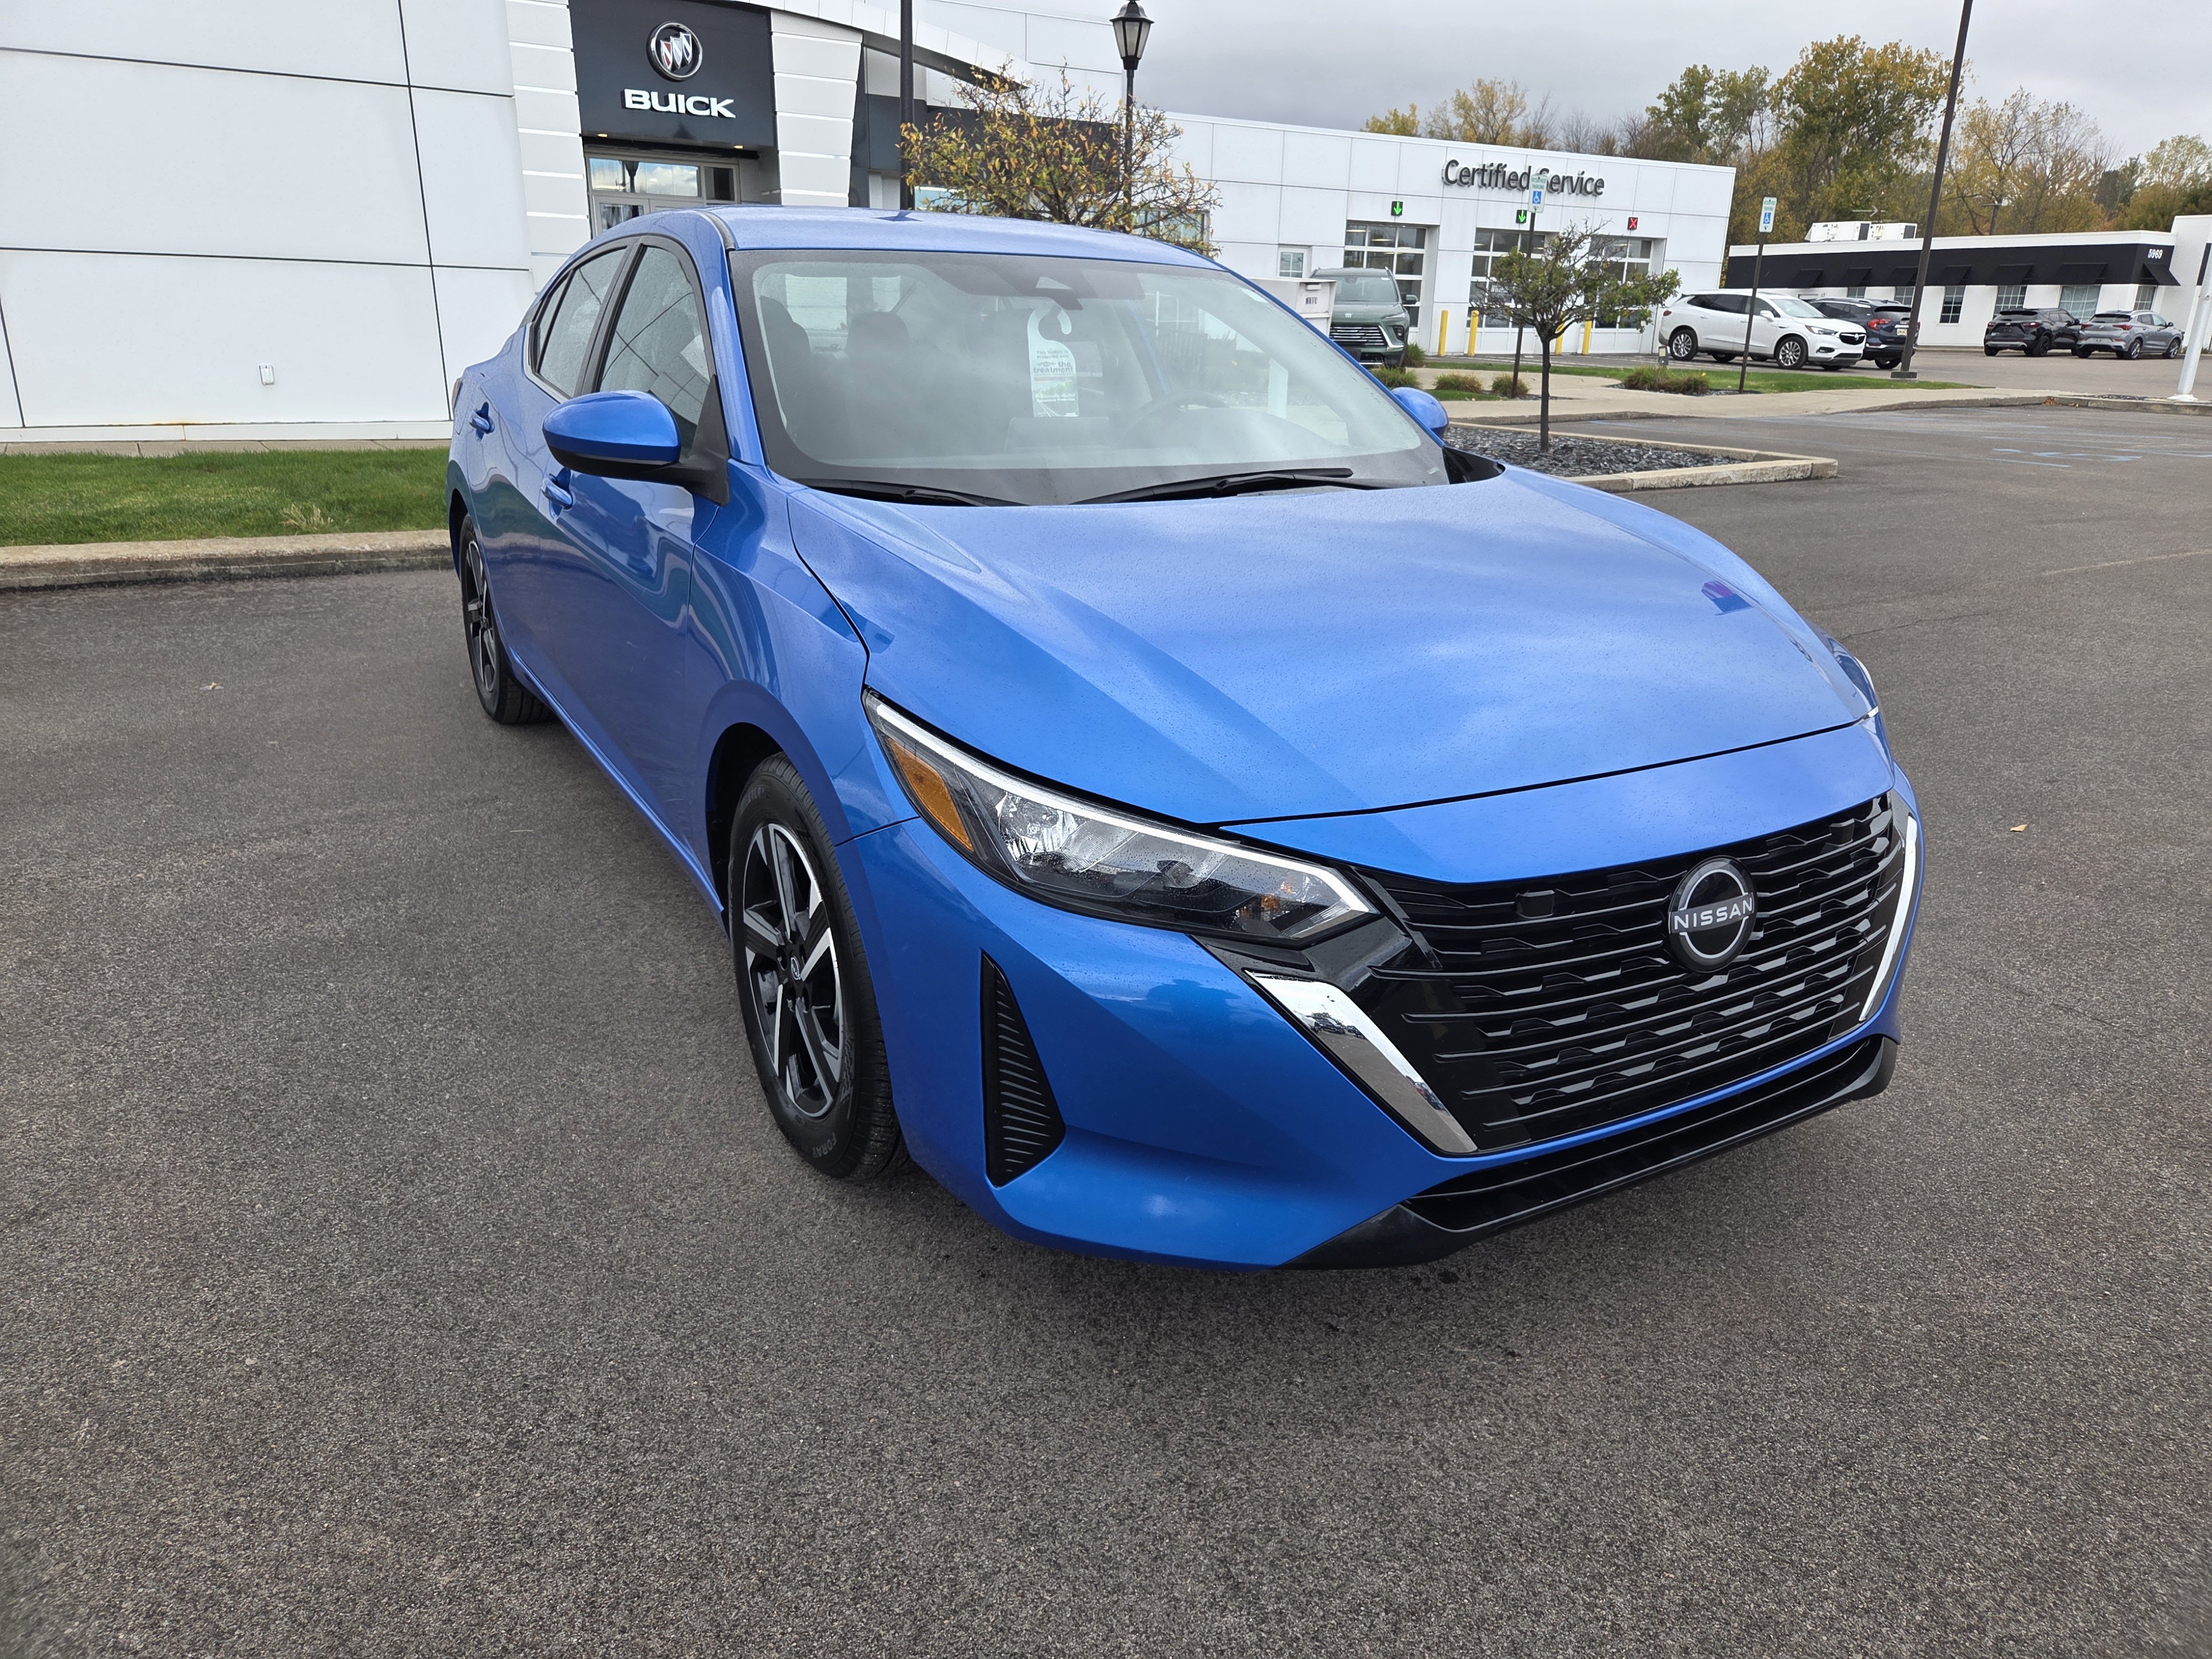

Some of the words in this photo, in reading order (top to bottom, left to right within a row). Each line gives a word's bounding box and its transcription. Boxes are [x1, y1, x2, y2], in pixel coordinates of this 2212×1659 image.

[624, 88, 736, 118] BUICK
[1443, 159, 1532, 190] Certified
[2148, 248, 2163, 259] 5969
[1674, 897, 1752, 930] NISSAN
